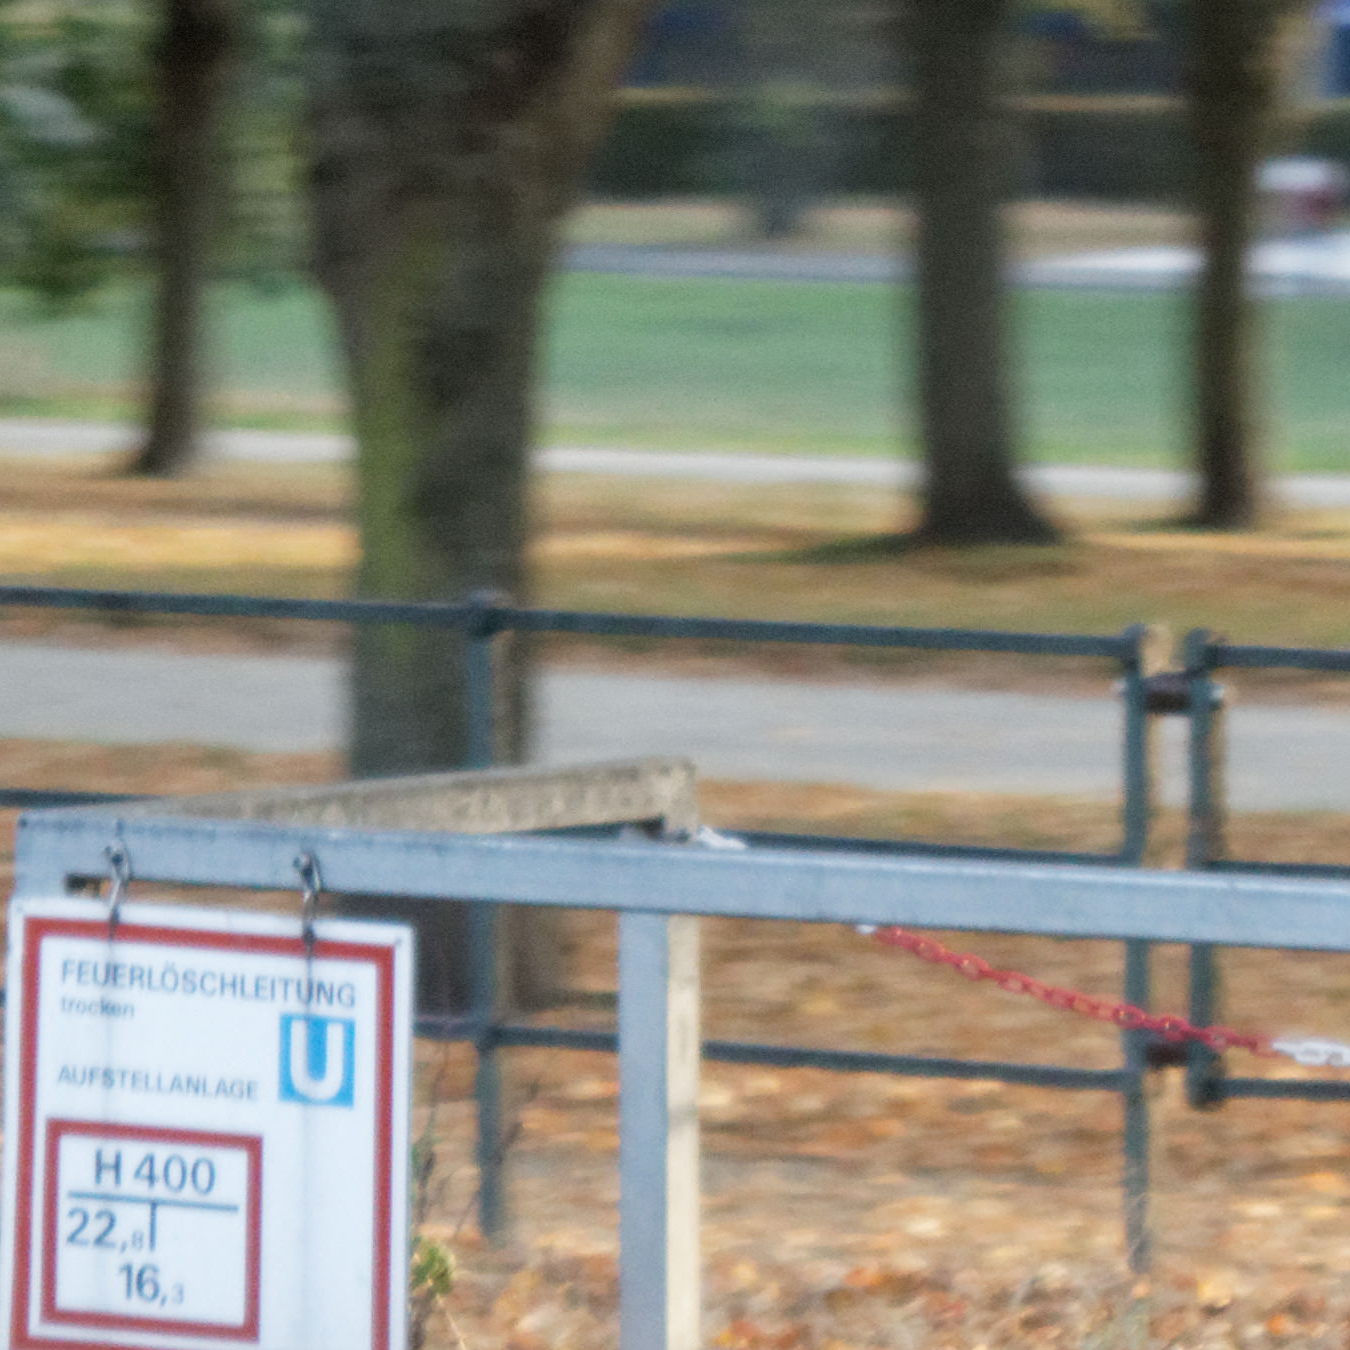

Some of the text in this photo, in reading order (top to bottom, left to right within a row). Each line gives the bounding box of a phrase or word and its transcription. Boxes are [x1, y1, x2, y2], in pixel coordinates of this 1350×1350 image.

[61, 959, 356, 1008] FEUERLÖSCHLEITUNG
[60, 996, 136, 1019] trocken
[57, 1065, 260, 1101] AUFSTELLANLAGE
[290, 1020, 345, 1100] U
[94, 1148, 217, 1195] H 400
